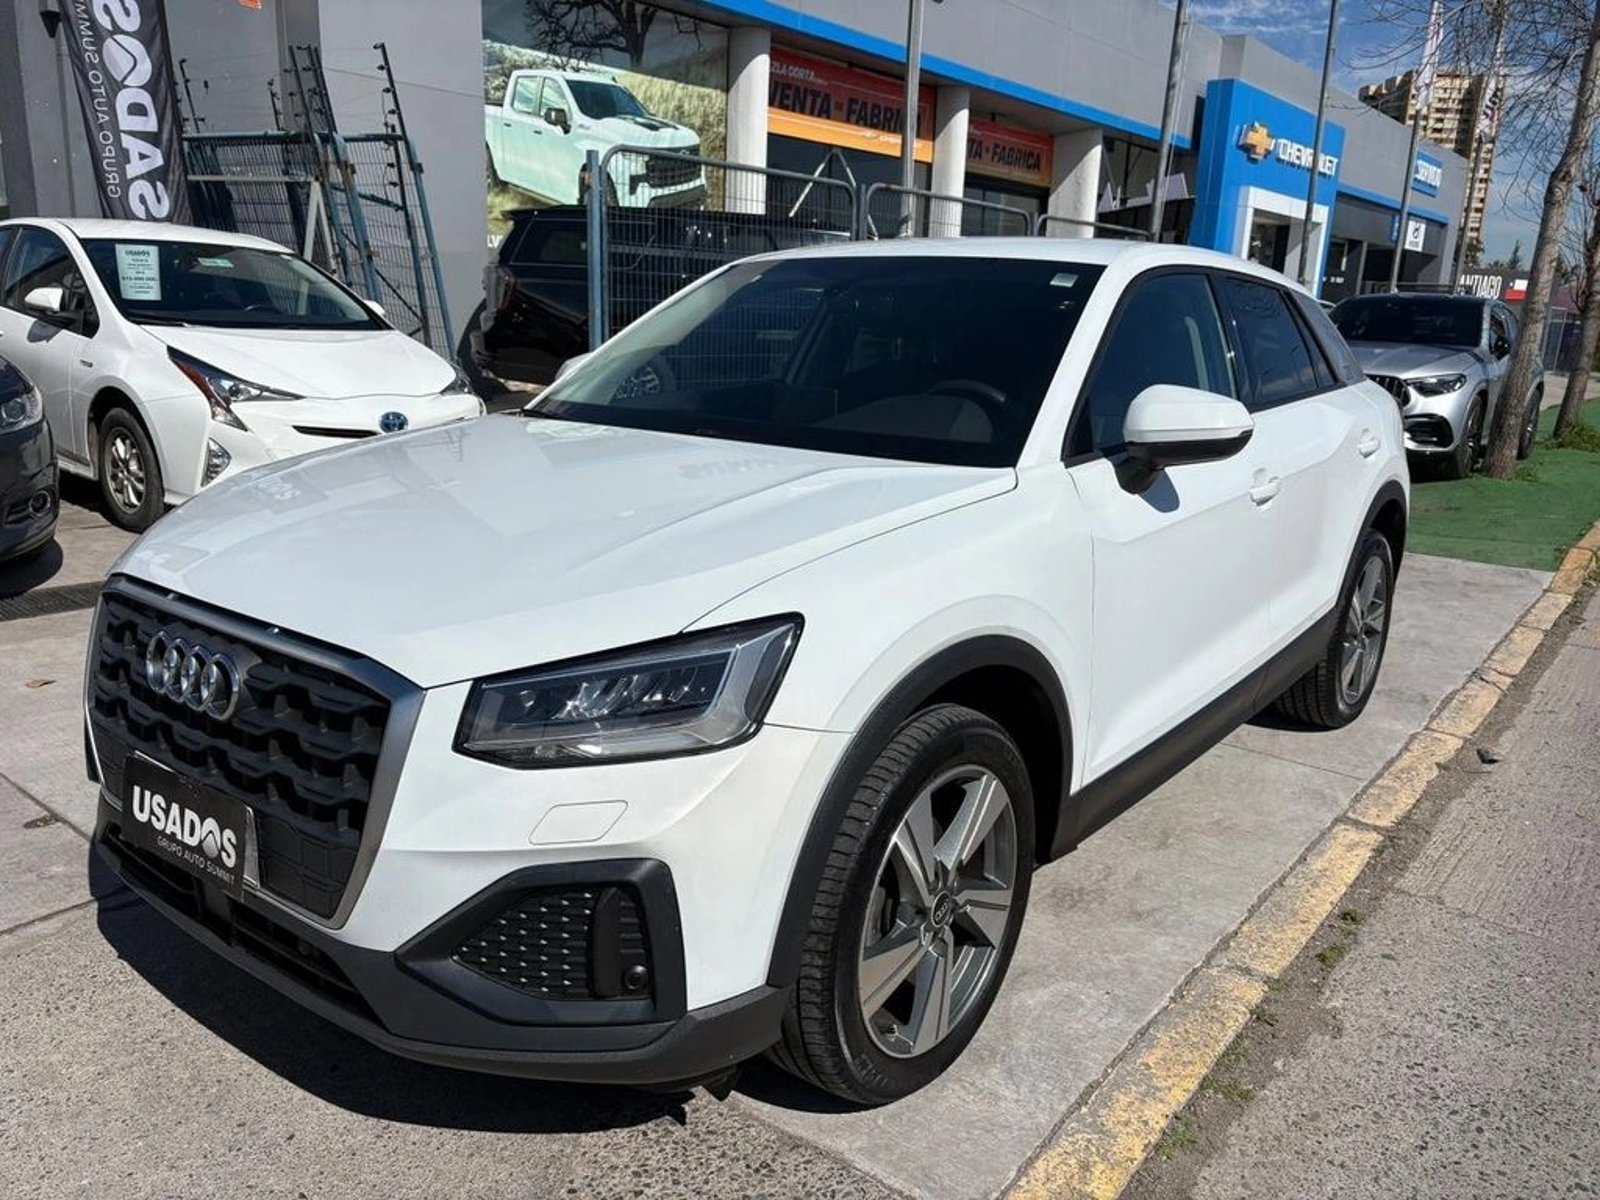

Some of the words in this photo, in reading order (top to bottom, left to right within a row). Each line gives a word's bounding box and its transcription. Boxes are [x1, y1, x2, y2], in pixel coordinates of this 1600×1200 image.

[768, 80, 832, 120] VENTA
[846, 97, 921, 138] FABRI
[991, 142, 1042, 171] FABRICA
[1277, 138, 1339, 176] CHEVRLET
[1458, 274, 1502, 300] ANTIAGO
[132, 784, 237, 868] USADOS
[157, 836, 183, 857] GRUPO
[183, 849, 206, 869] AUTO
[206, 861, 236, 884] SUMMIT
